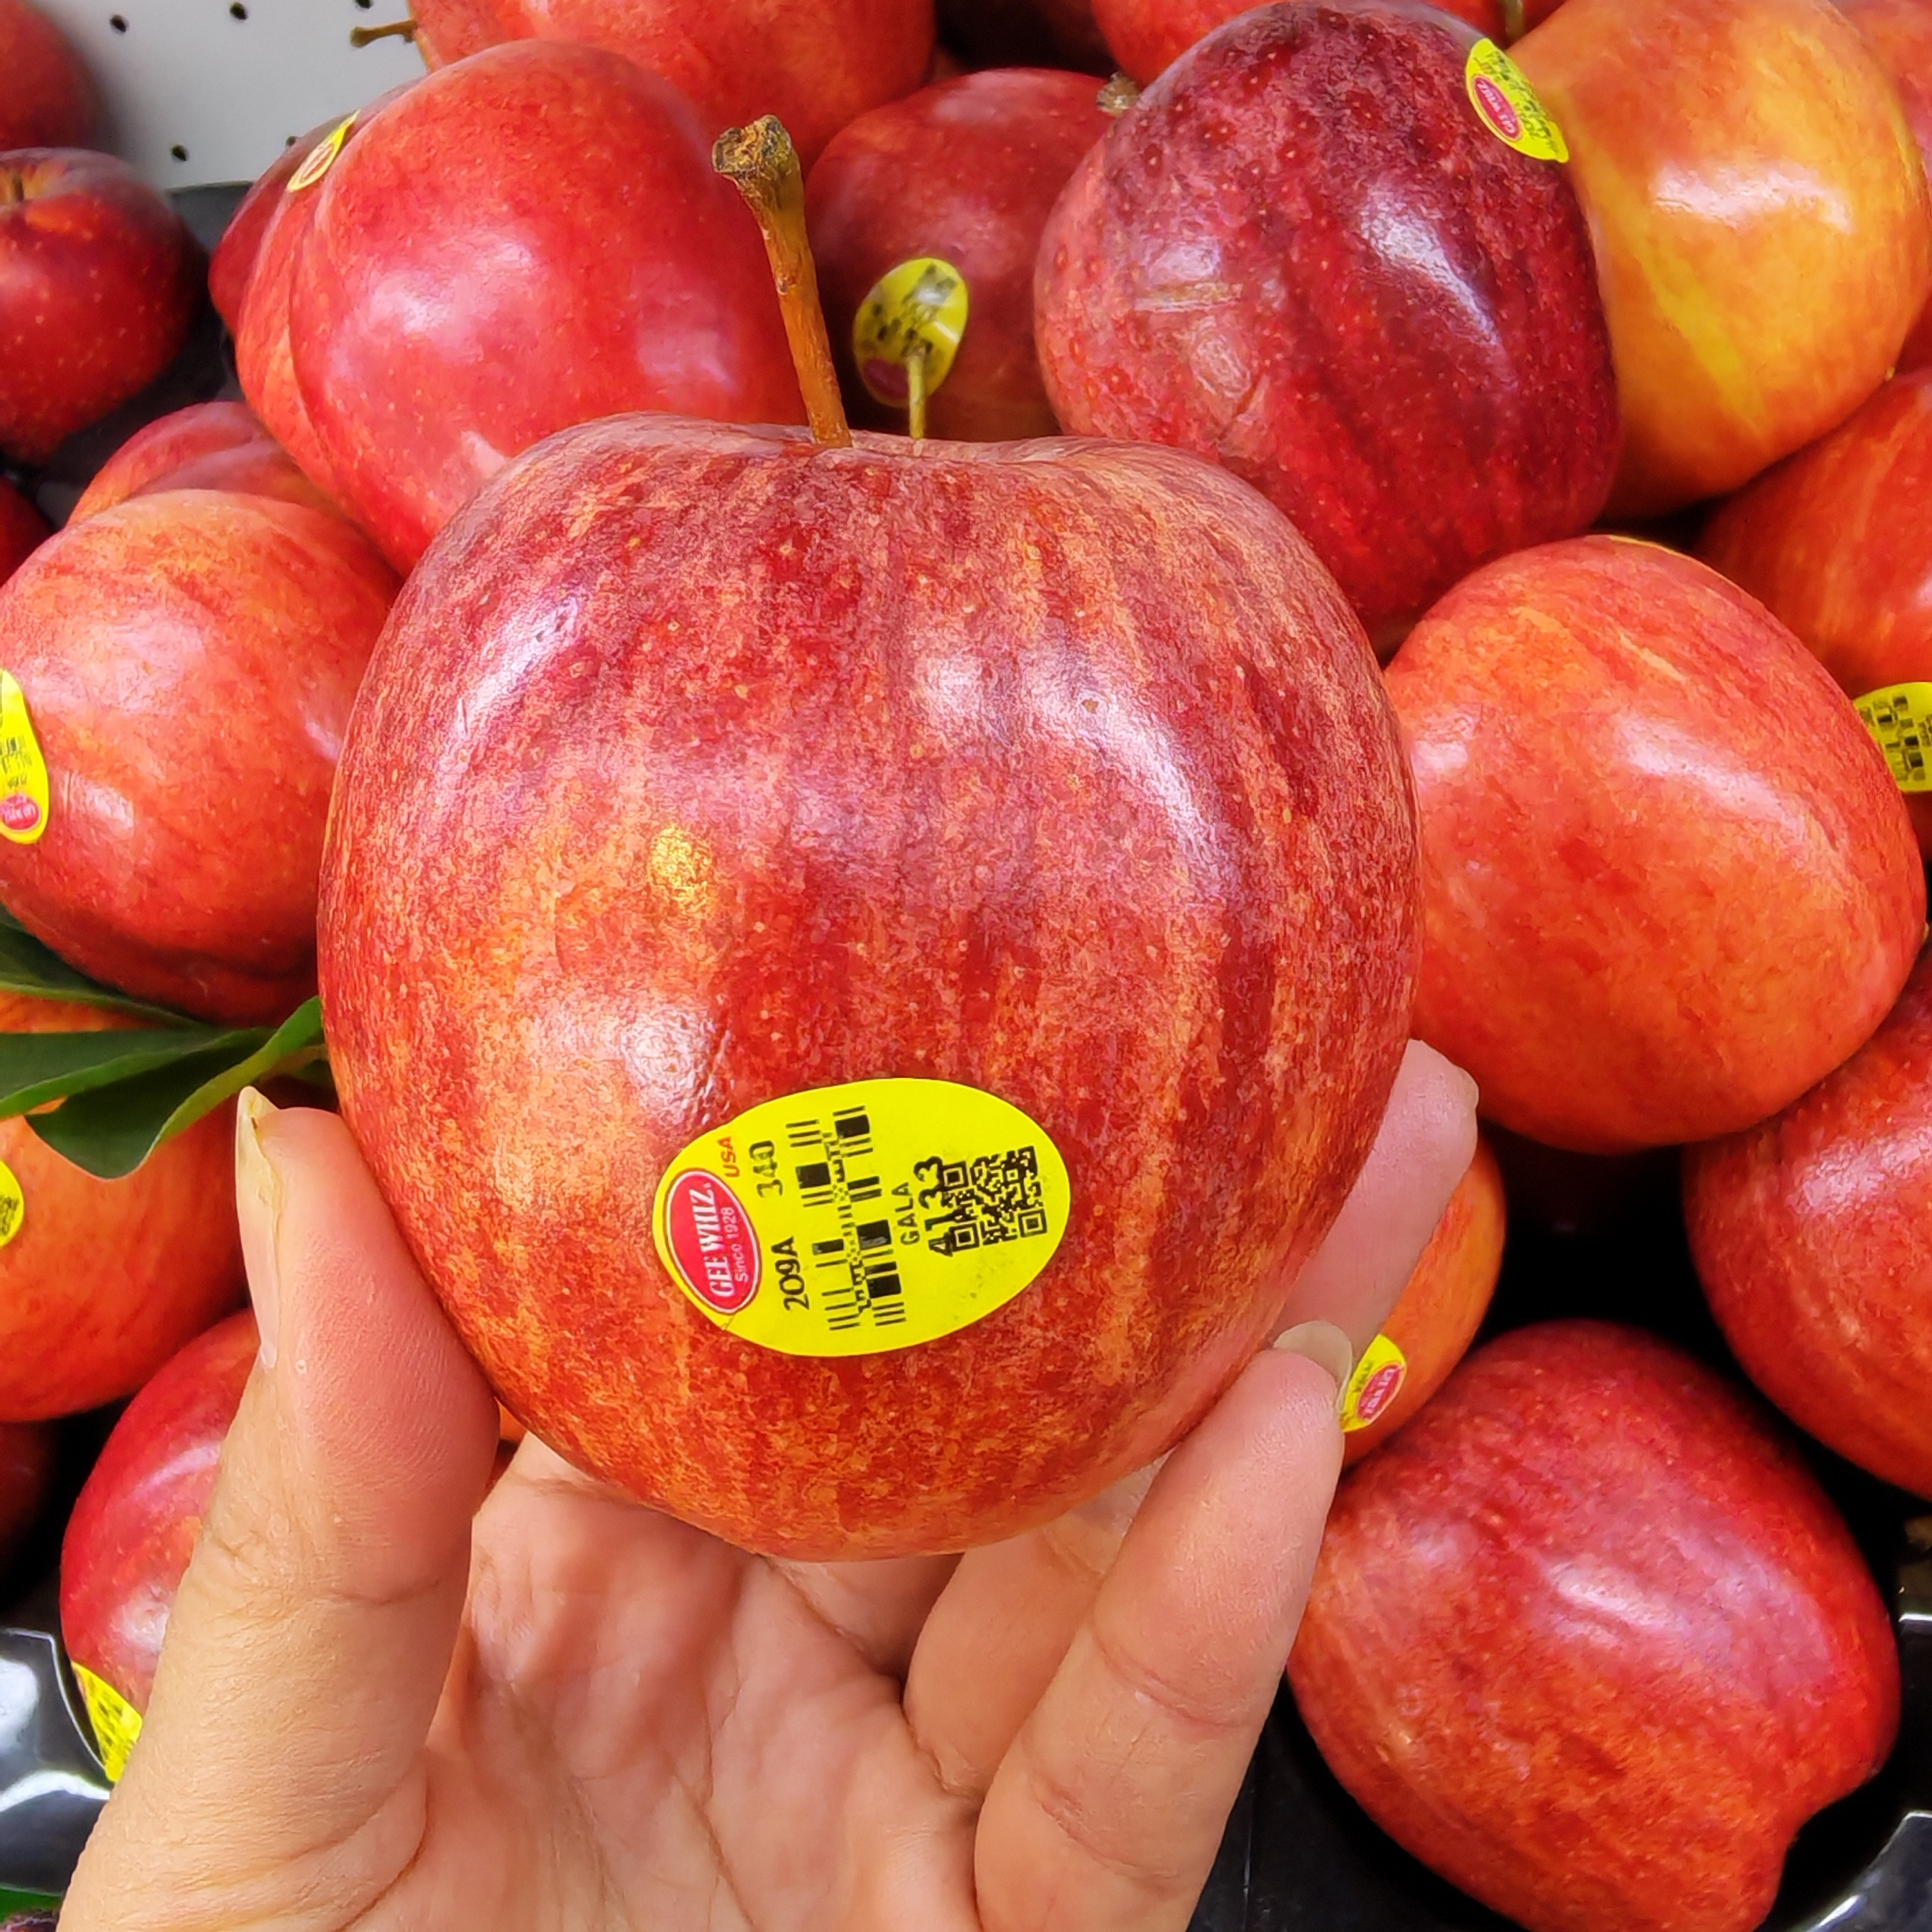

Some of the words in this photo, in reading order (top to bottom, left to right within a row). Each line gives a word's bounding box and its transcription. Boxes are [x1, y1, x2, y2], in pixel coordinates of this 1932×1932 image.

[717, 1136, 740, 1178] USA
[749, 1141, 783, 1198] 340
[688, 1189, 724, 1252] WHIZ
[720, 1207, 739, 1240] 1928
[891, 1182, 920, 1245] GALA
[913, 1156, 956, 1258] 4133
[704, 1256, 735, 1297] GEE
[731, 1244, 749, 1282] Since
[771, 1236, 810, 1311] 209A
